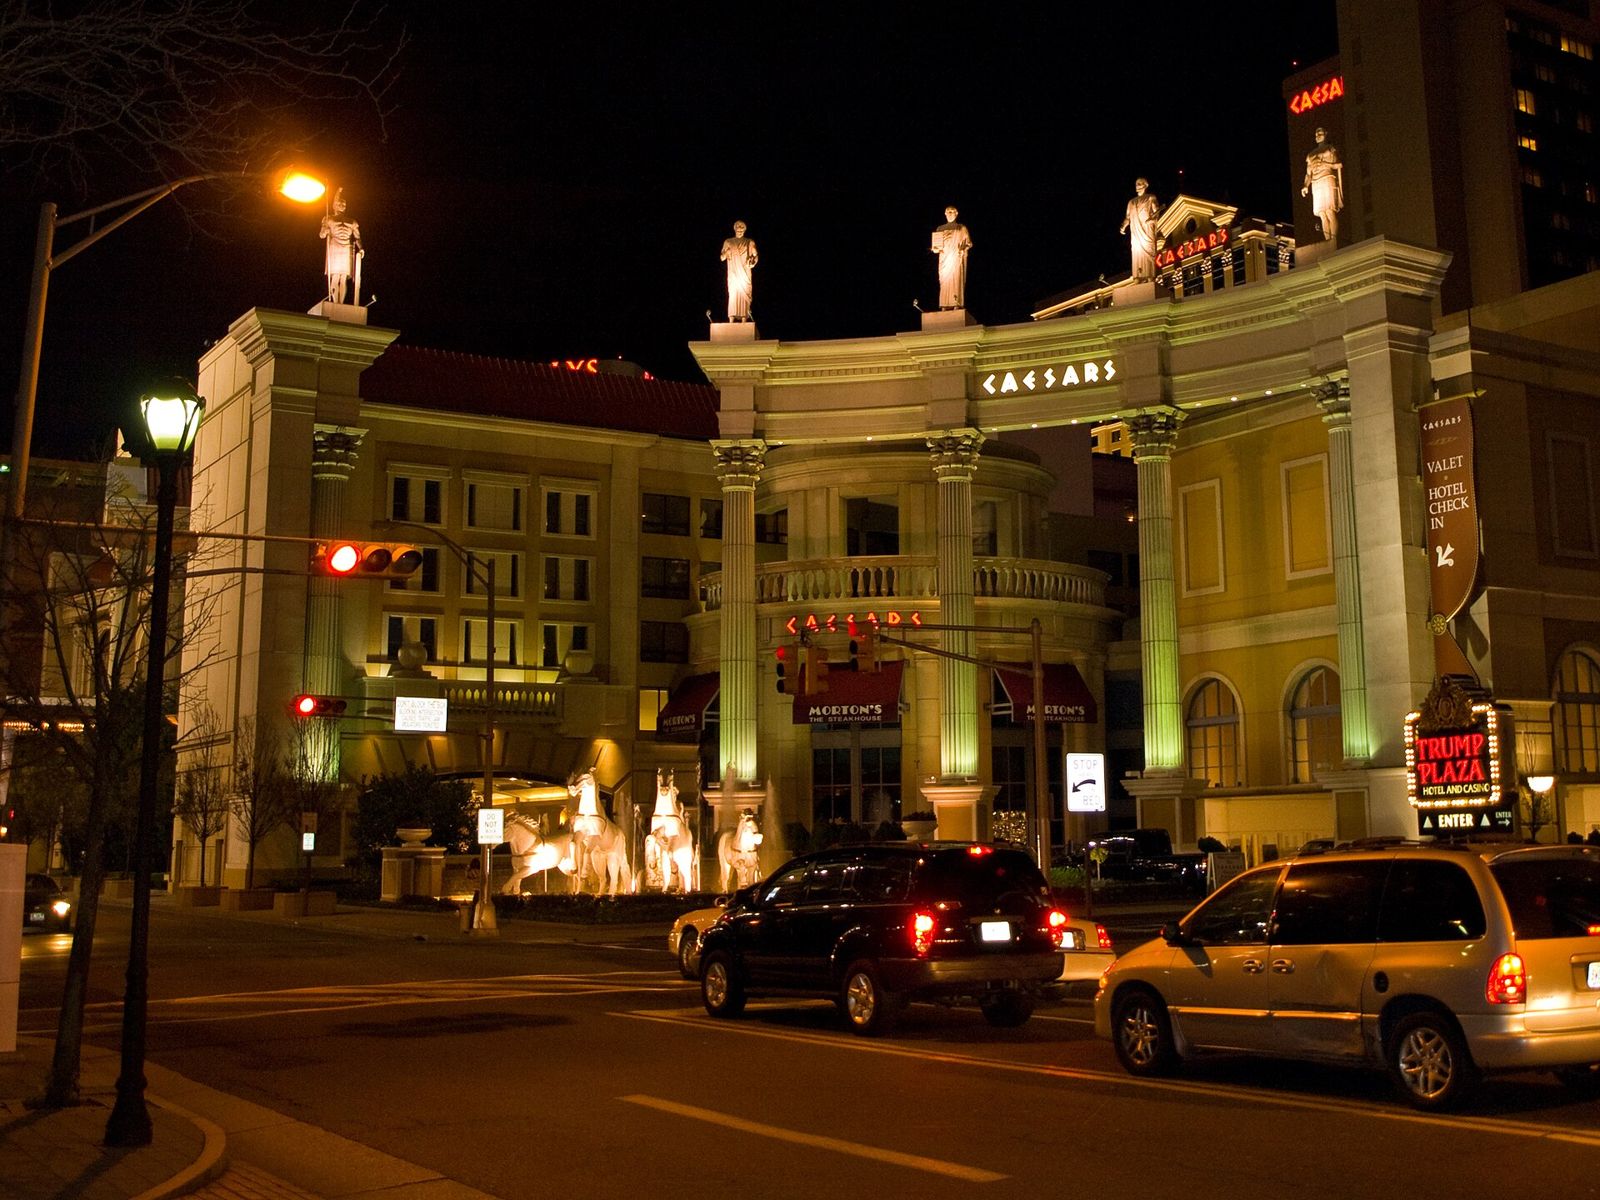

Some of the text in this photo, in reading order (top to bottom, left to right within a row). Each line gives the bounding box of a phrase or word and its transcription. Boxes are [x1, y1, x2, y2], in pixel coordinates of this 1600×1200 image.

[1290, 76, 1343, 114] CAESA
[1156, 228, 1228, 267] CAESARS
[982, 359, 1117, 395] CAESARS
[1423, 415, 1462, 431] CAESARS
[1427, 455, 1464, 473] VALET
[1428, 482, 1467, 501] HOTEL
[1429, 496, 1470, 515] CHECK
[1430, 516, 1445, 530] IN
[809, 704, 882, 716] MORTON'S
[1026, 704, 1085, 715] MRTON'S
[828, 715, 882, 723] STEAKHOUSE
[1415, 733, 1485, 760] TRUMP
[1073, 759, 1097, 770] STOP
[1417, 759, 1485, 784] PLAZA
[1423, 783, 1490, 795] HOTEL AND CASINO
[1438, 813, 1474, 828] ENTER
[1495, 811, 1512, 819] ENTER
